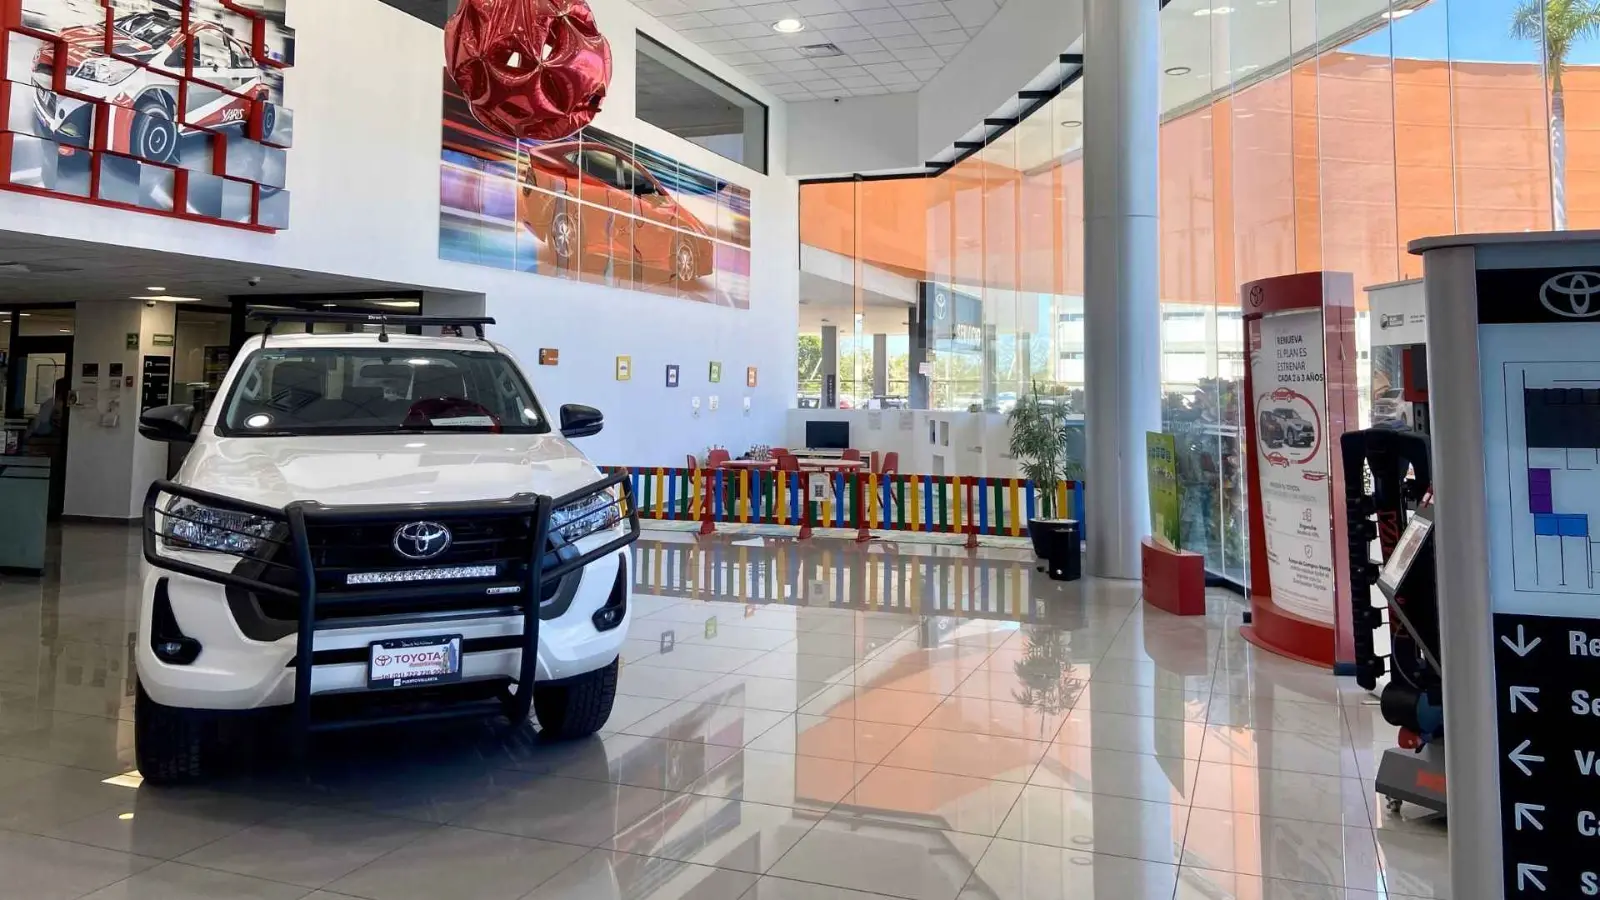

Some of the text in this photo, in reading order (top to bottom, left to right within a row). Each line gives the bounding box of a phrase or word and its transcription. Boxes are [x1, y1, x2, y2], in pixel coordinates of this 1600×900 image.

[221, 108, 245, 122] YARIS
[1276, 335, 1303, 345] RENUEVA
[1284, 348, 1299, 358] PLAN
[1299, 347, 1307, 357] ES
[1277, 361, 1306, 371] ESTRENAR
[1306, 371, 1324, 382] AÑOS
[394, 652, 441, 664] TOYOTA
[1574, 749, 1600, 777] V
[1577, 810, 1600, 837] C
